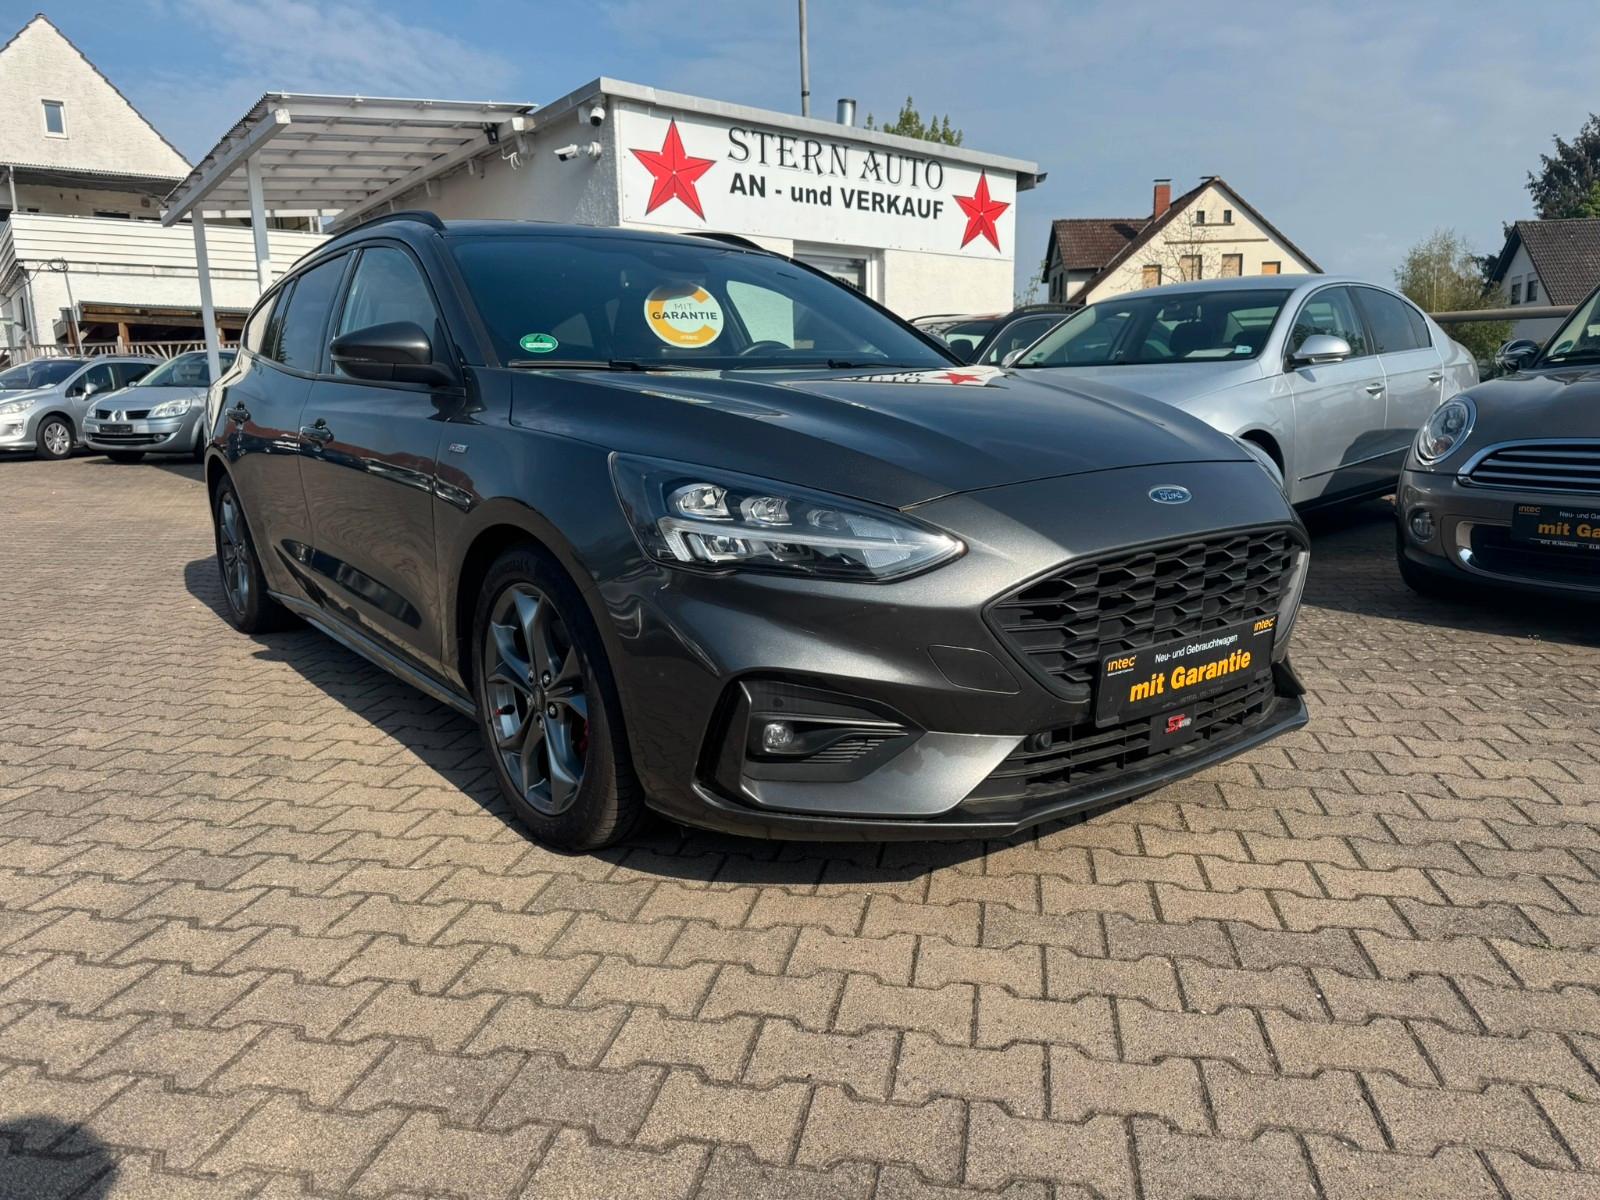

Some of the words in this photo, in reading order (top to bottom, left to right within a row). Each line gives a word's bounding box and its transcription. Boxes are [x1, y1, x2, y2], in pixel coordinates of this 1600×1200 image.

[727, 126, 849, 179] STERN
[859, 150, 945, 191] AUTO
[729, 172, 766, 198] AN
[790, 184, 832, 207] und
[840, 188, 944, 220] VERKAUF
[674, 302, 693, 311] MIT
[652, 311, 718, 321] GARANTIE
[1537, 522, 1571, 536] mit
[1577, 523, 1600, 539] Ga
[1253, 616, 1276, 633] intec
[1155, 652, 1171, 664] Neu-
[1172, 647, 1185, 659] und
[1186, 633, 1238, 655] Gebrauchtwagen
[1107, 655, 1136, 672] intec
[1129, 671, 1166, 703] mit
[1170, 649, 1251, 690] Garantie
